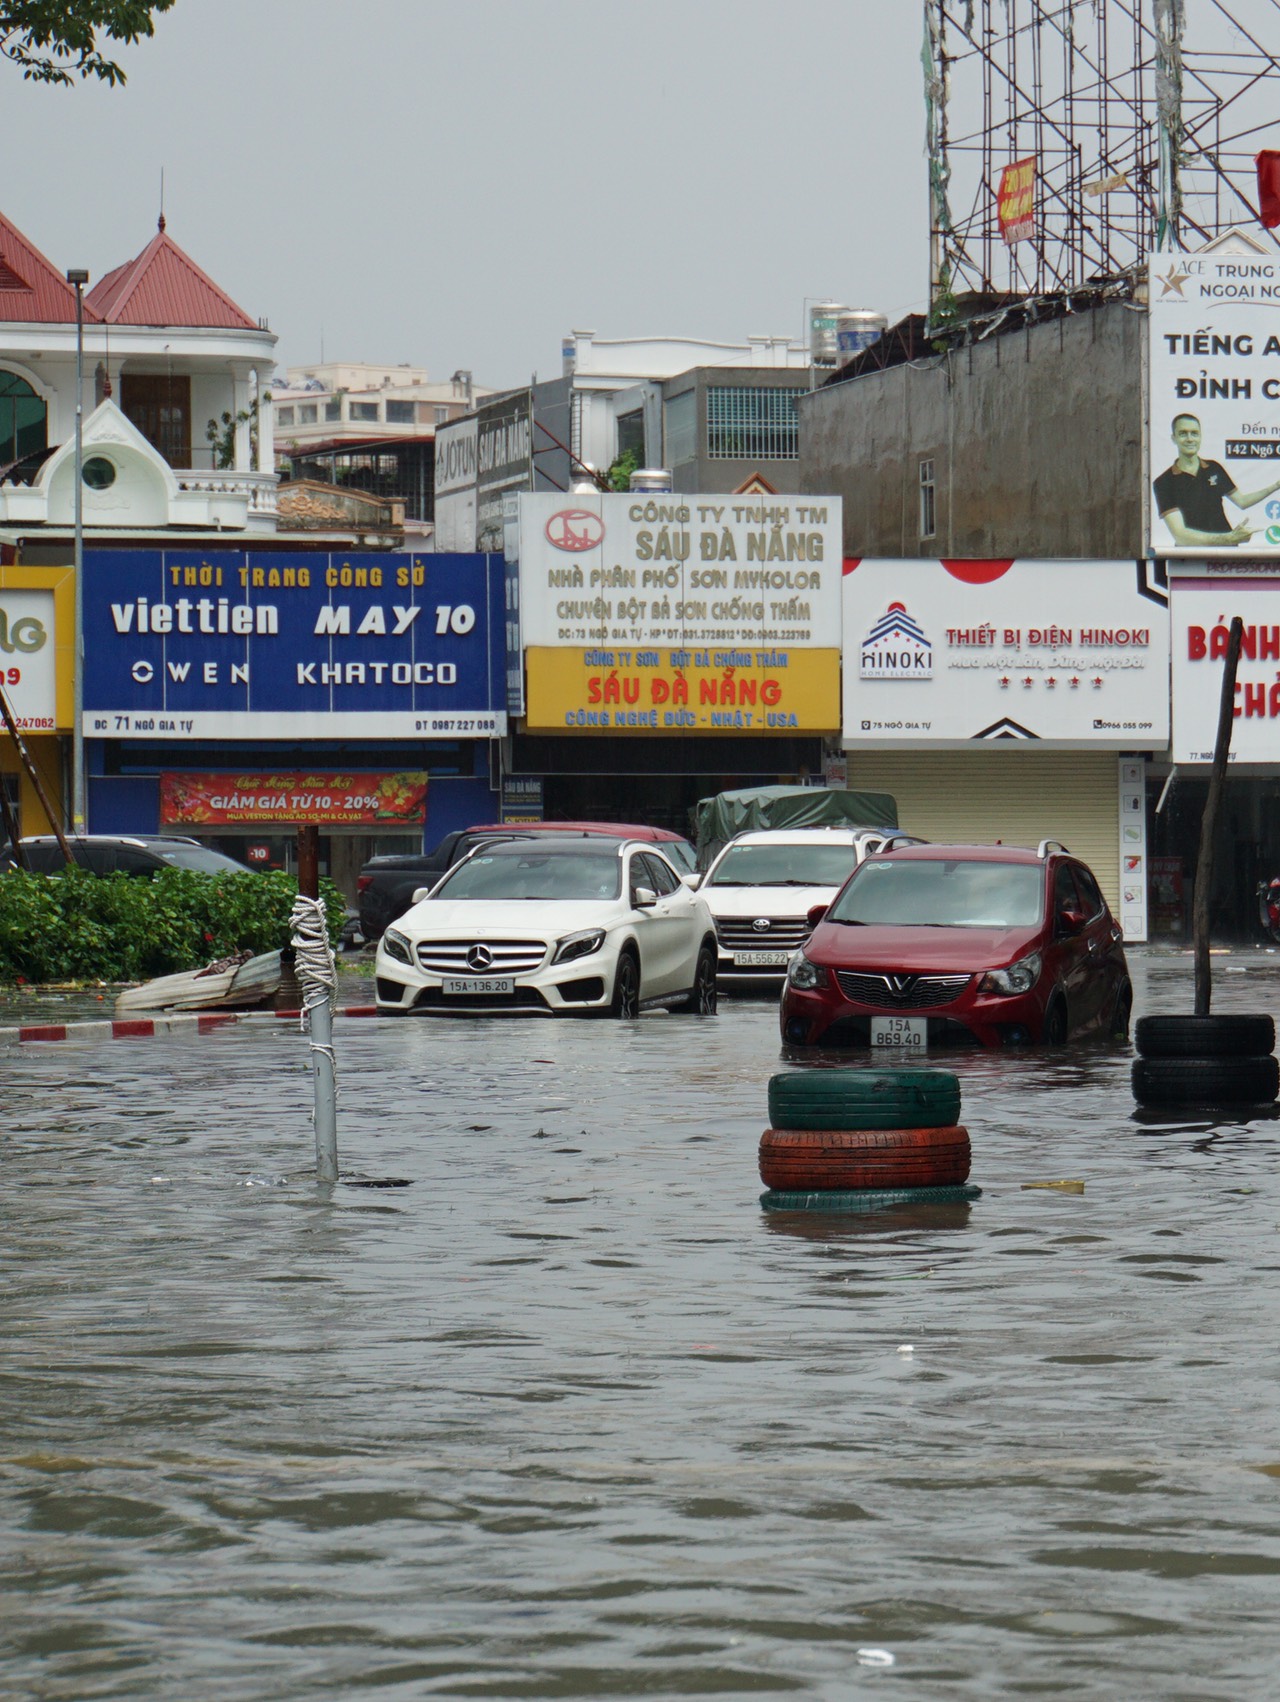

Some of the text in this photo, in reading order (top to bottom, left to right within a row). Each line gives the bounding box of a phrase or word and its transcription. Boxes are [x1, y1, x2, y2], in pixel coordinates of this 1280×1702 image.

[1177, 260, 1206, 275] ACE
[1215, 265, 1274, 278] TRUNG
[1200, 284, 1257, 301] NGOẠI
[1164, 326, 1253, 356] TIẾNG
[1175, 370, 1251, 400] ĐỈNH
[1242, 422, 1267, 435] Đến
[1227, 444, 1248, 456] 142
[1250, 443, 1273, 458] Ngô
[629, 502, 827, 524] CÔNG TY TNHH TM
[636, 524, 823, 561] SÁU ĐÀ NẴNG
[170, 560, 425, 587] THỜI TRANG CÔNG SỞ
[548, 564, 584, 588] NHÀ
[590, 565, 636, 588] PHÂN
[690, 569, 728, 589] SƠN
[734, 570, 821, 590] MYKOLOR
[111, 597, 279, 634] viettien
[314, 605, 421, 634] MAY
[435, 604, 476, 634] 10
[557, 596, 612, 620] CHUYÊN
[617, 596, 647, 624] BỘT
[675, 600, 707, 620] SƠN
[711, 595, 764, 621] CHỐNG
[770, 596, 811, 621] THẤM
[946, 623, 1150, 650] THIẾT BỊ ĐIỆN HINOKI
[1188, 615, 1280, 660] BÁNH
[584, 649, 614, 666] CÔNG
[619, 652, 632, 666] TY
[862, 651, 932, 668] HINOKI
[132, 660, 457, 685] OWEN KHATOCO
[588, 667, 782, 706] SÁU ĐÀ NẴNG
[115, 716, 130, 731] 71
[135, 718, 154, 731] NGÔ
[159, 721, 175, 731] GIA
[180, 719, 193, 733] TỰ
[432, 720, 455, 730] 0987
[457, 720, 475, 730] 227
[477, 720, 495, 730] 088
[565, 708, 610, 727] CÔNG
[615, 709, 658, 728] NGHỆ
[711, 709, 753, 729] NHẬT
[767, 711, 799, 727] USA
[884, 720, 903, 729] NGÔ
[210, 792, 379, 809] GIẢM GIÁ TỪ 10 20%
[449, 979, 508, 992] 15A-136.20
[889, 1019, 911, 1031] 15A
[876, 1032, 921, 1045] 869.40
